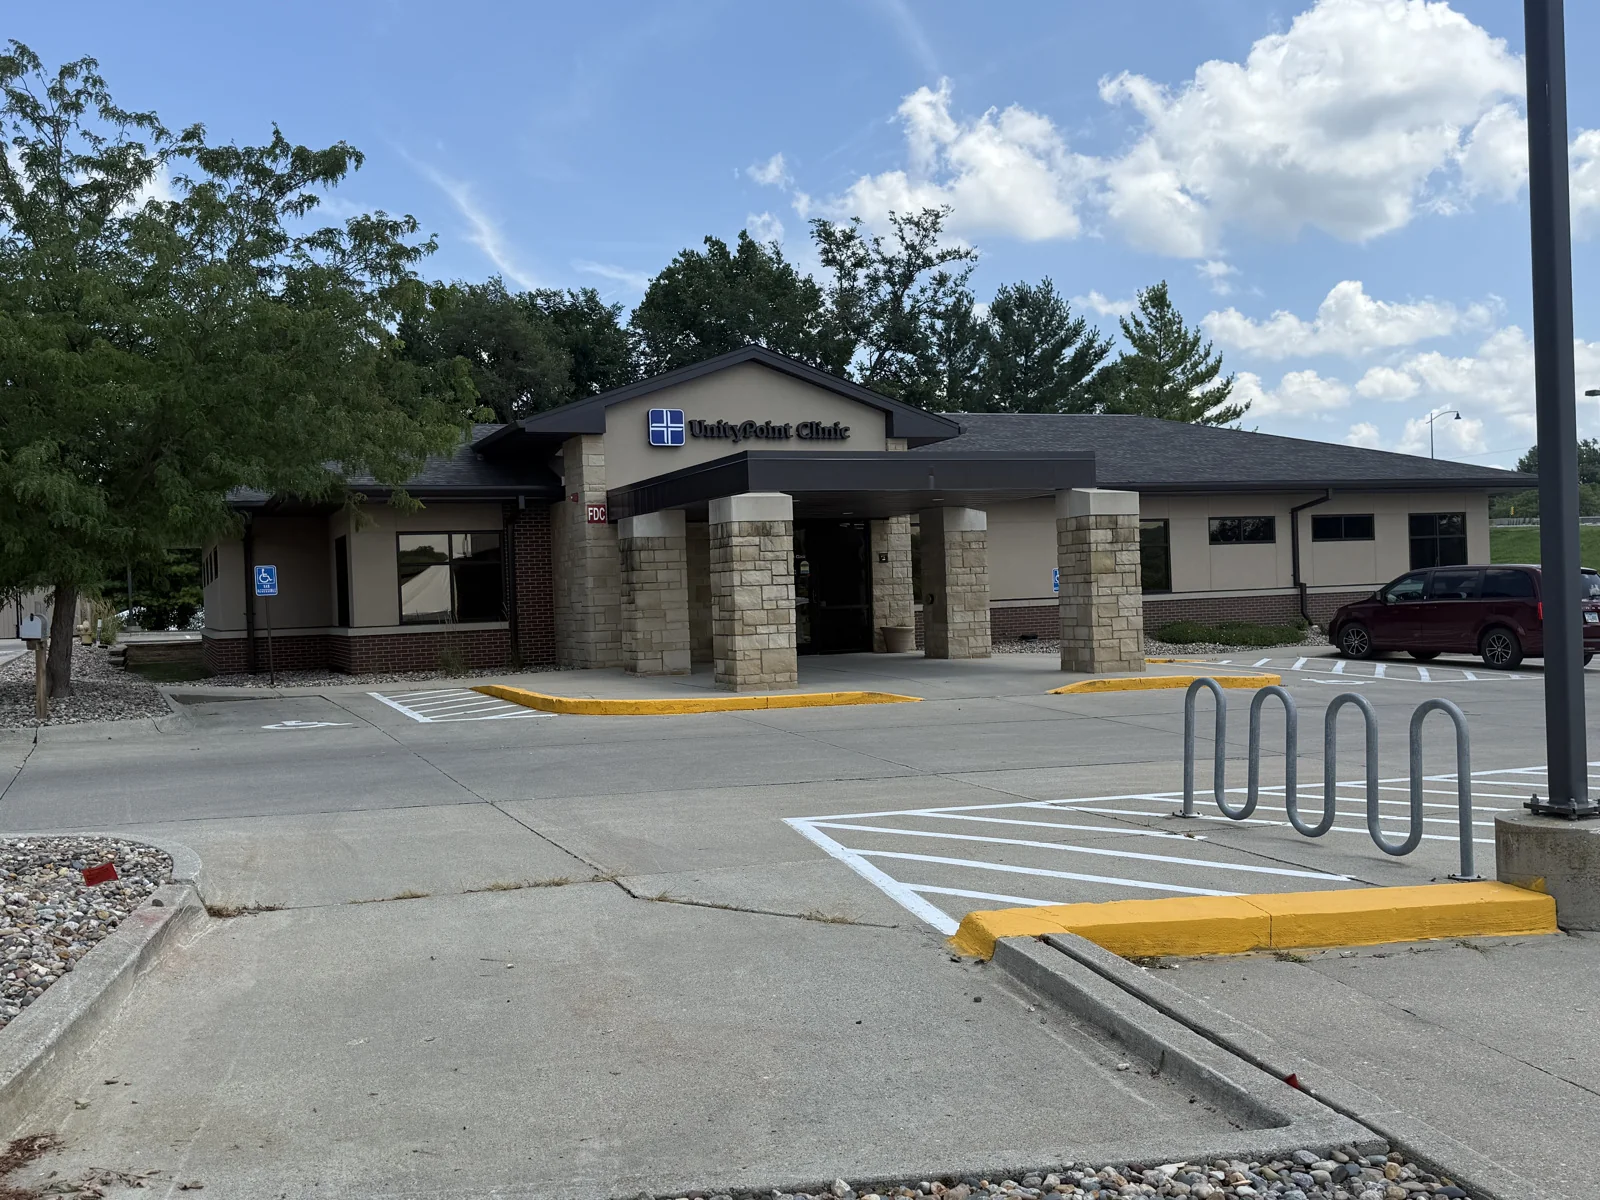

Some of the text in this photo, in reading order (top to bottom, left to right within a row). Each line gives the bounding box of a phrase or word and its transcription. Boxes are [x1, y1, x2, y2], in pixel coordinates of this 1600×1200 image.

[689, 419, 850, 442] UnityPoint Clinic
[588, 507, 606, 521] FDC
